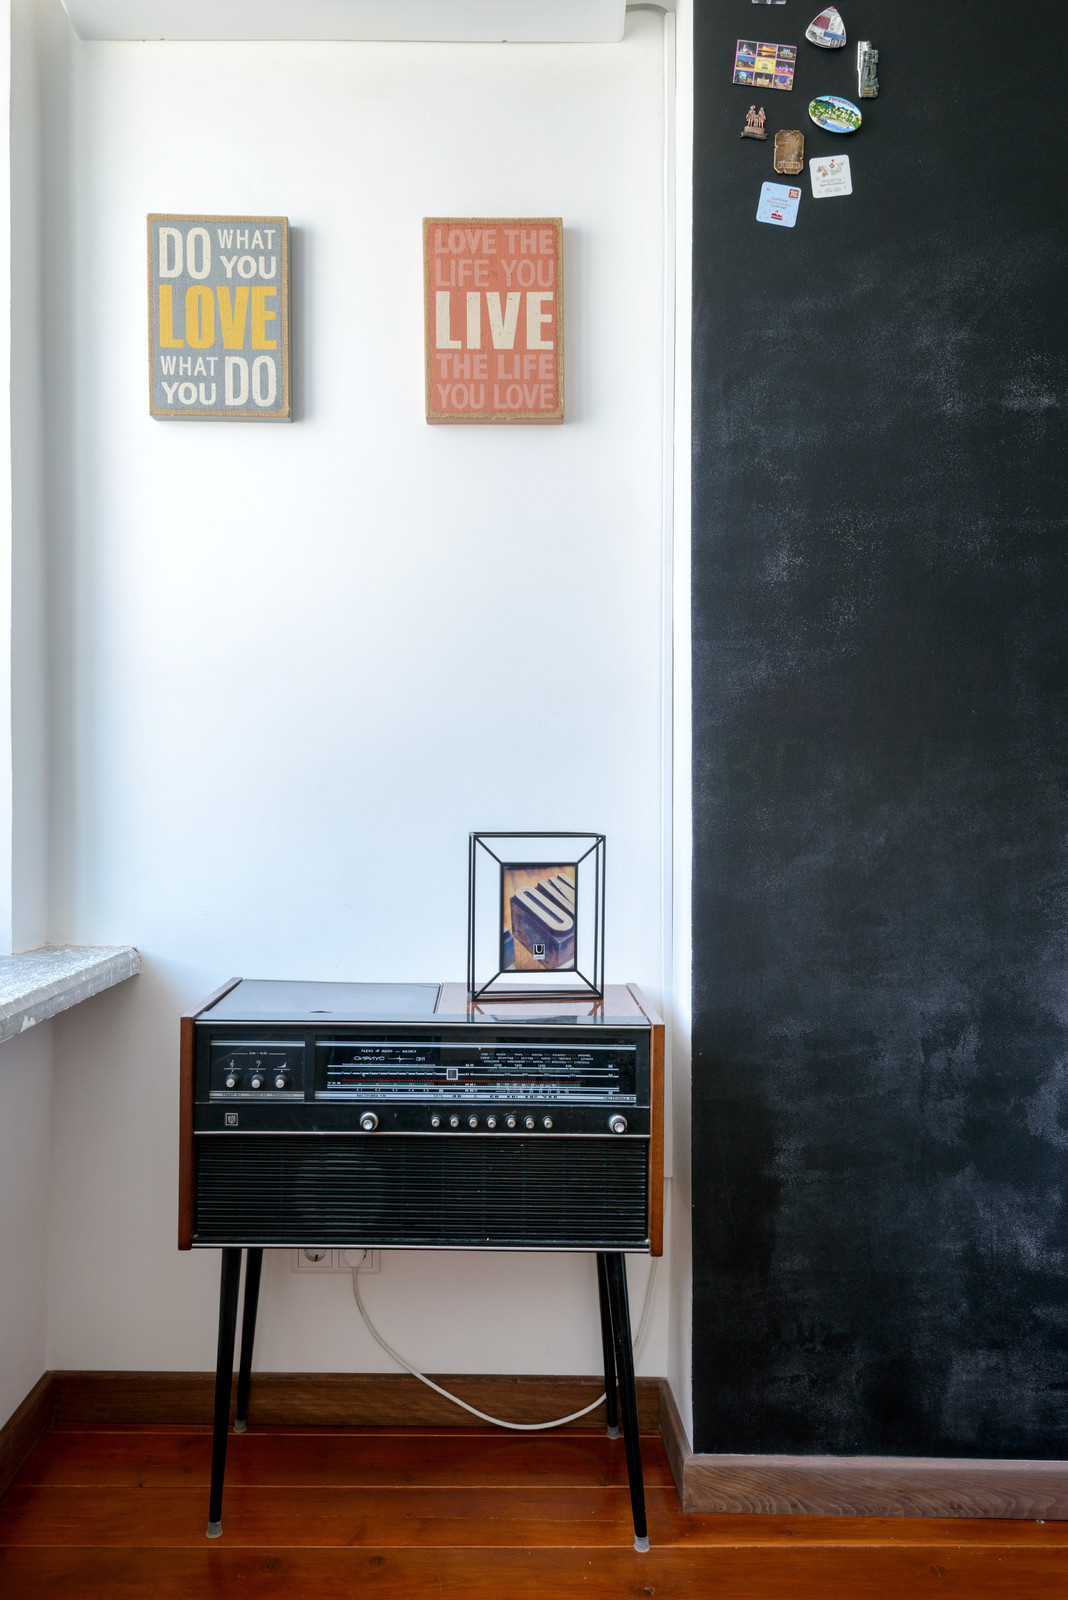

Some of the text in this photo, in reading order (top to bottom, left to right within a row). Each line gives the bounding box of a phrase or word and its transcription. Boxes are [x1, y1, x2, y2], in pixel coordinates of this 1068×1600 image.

[217, 228, 276, 250] WHAT
[434, 229, 554, 254] LOVE THE
[159, 227, 211, 279] DO
[219, 255, 276, 280] YOU
[435, 258, 554, 288] LIFE YOU
[159, 284, 277, 350] LOVE
[435, 290, 554, 350] LIVE
[160, 355, 219, 377] WHAT
[436, 353, 554, 380] THE LIFE
[161, 381, 217, 406] YOU
[224, 355, 277, 407] DO
[436, 383, 554, 410] YOU LOVE
